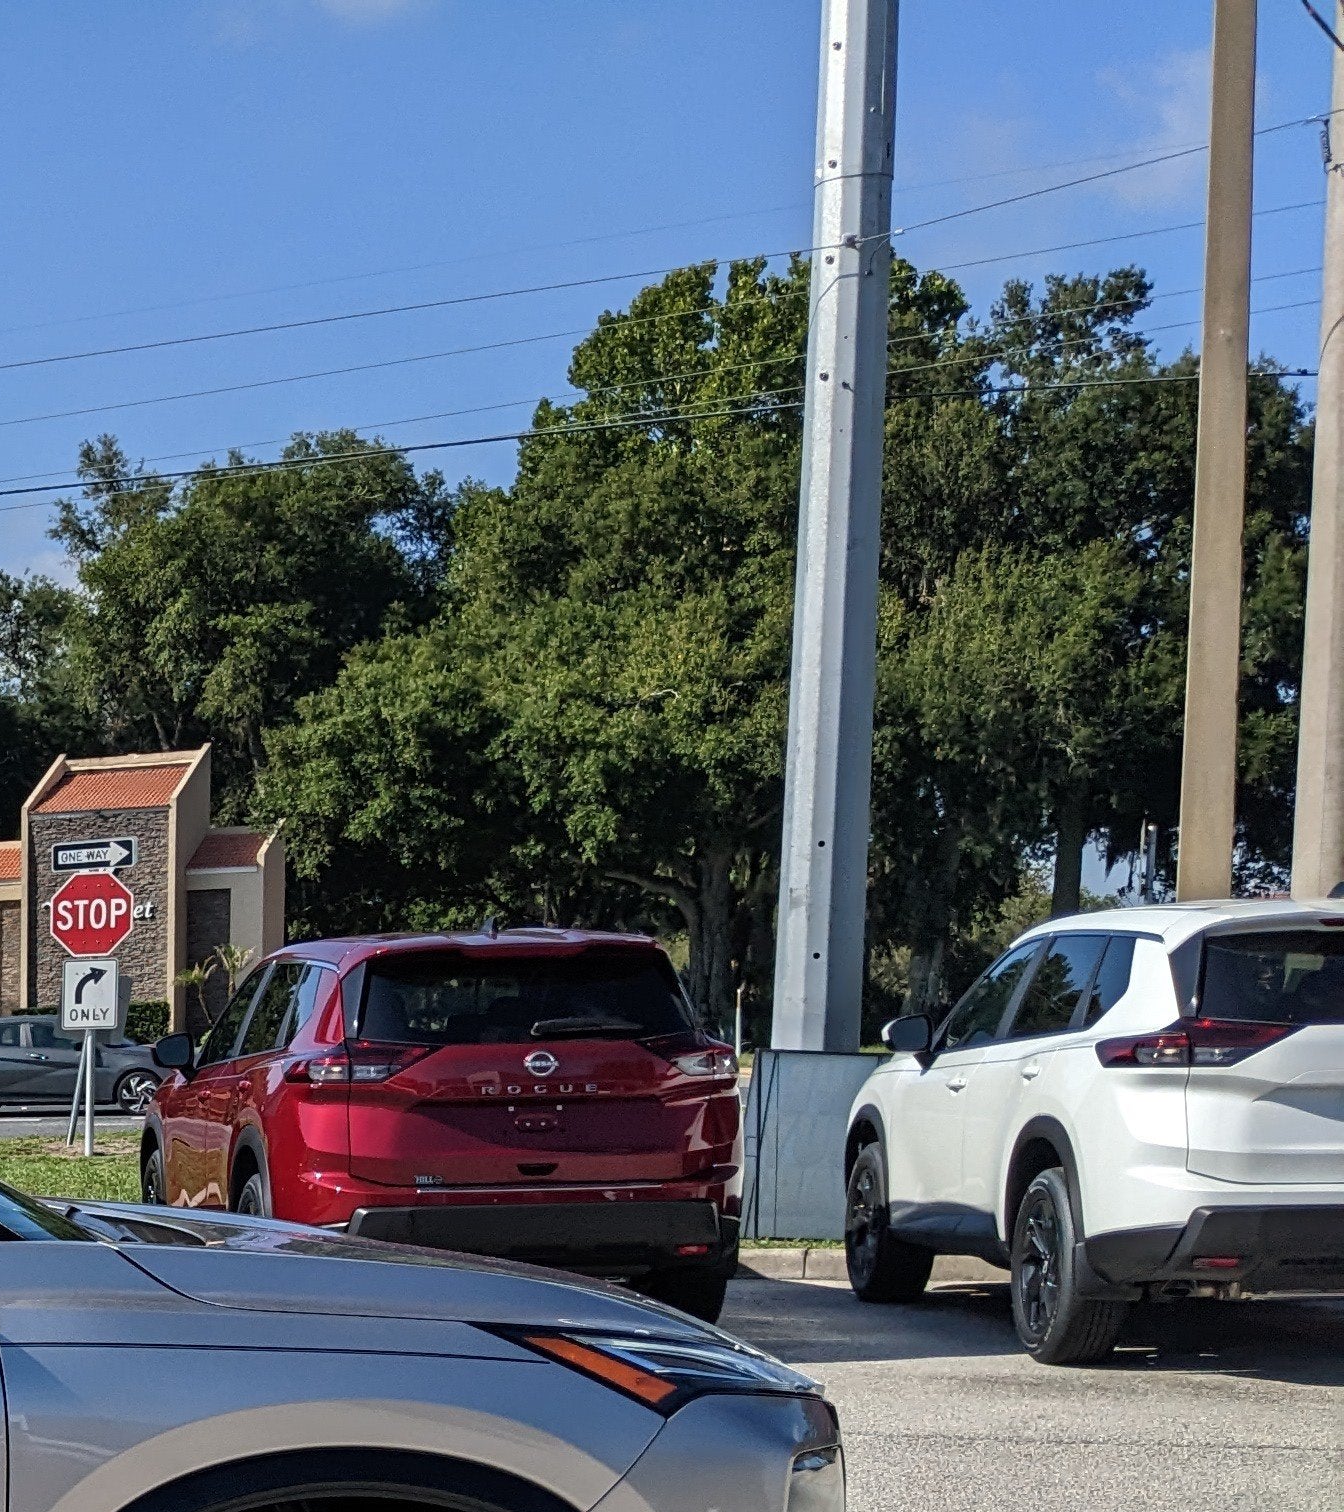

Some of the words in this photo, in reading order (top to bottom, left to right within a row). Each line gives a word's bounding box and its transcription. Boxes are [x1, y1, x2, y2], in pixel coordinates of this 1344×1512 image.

[60, 851, 83, 863] ONE
[86, 849, 108, 861] WAY
[56, 898, 127, 931] STOP
[133, 901, 155, 919] et
[69, 1008, 110, 1022] ONLY
[481, 1083, 598, 1095] ROGUE
